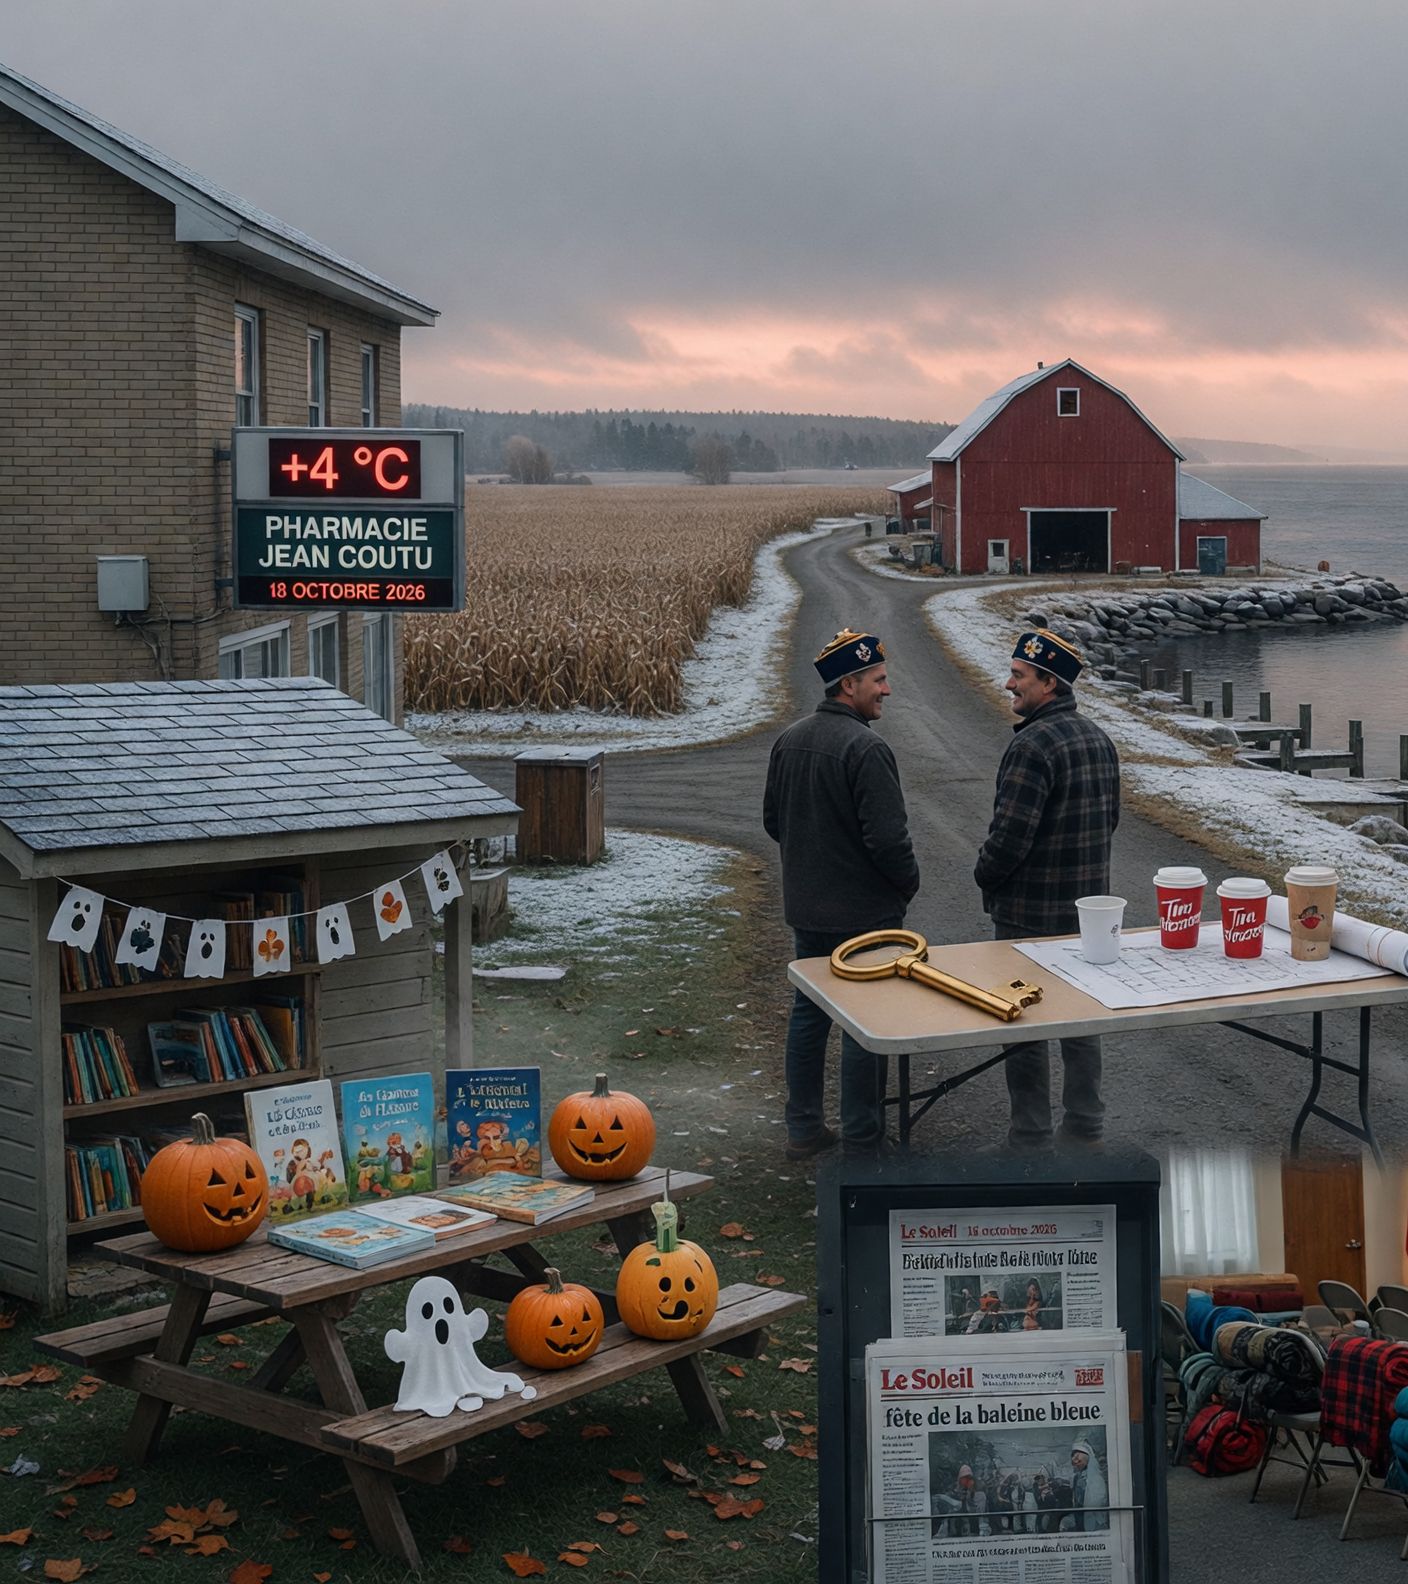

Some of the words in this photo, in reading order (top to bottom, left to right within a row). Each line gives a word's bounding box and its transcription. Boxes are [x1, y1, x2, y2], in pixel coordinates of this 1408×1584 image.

[281, 447, 339, 489] +4
[354, 446, 409, 491] °C
[265, 515, 428, 541] PHARMACIE
[258, 544, 330, 568] JEAN
[338, 545, 433, 570] COUTU
[269, 582, 287, 599] 18
[292, 582, 381, 600] OCTOBRE
[385, 583, 426, 601] 2026
[880, 1369, 908, 1391] Le
[911, 1367, 974, 1391] Soleil
[885, 1407, 922, 1428] fête
[927, 1405, 951, 1426] de
[955, 1404, 973, 1425] la
[977, 1402, 1046, 1425] baleine
[1050, 1401, 1101, 1422] bleue
